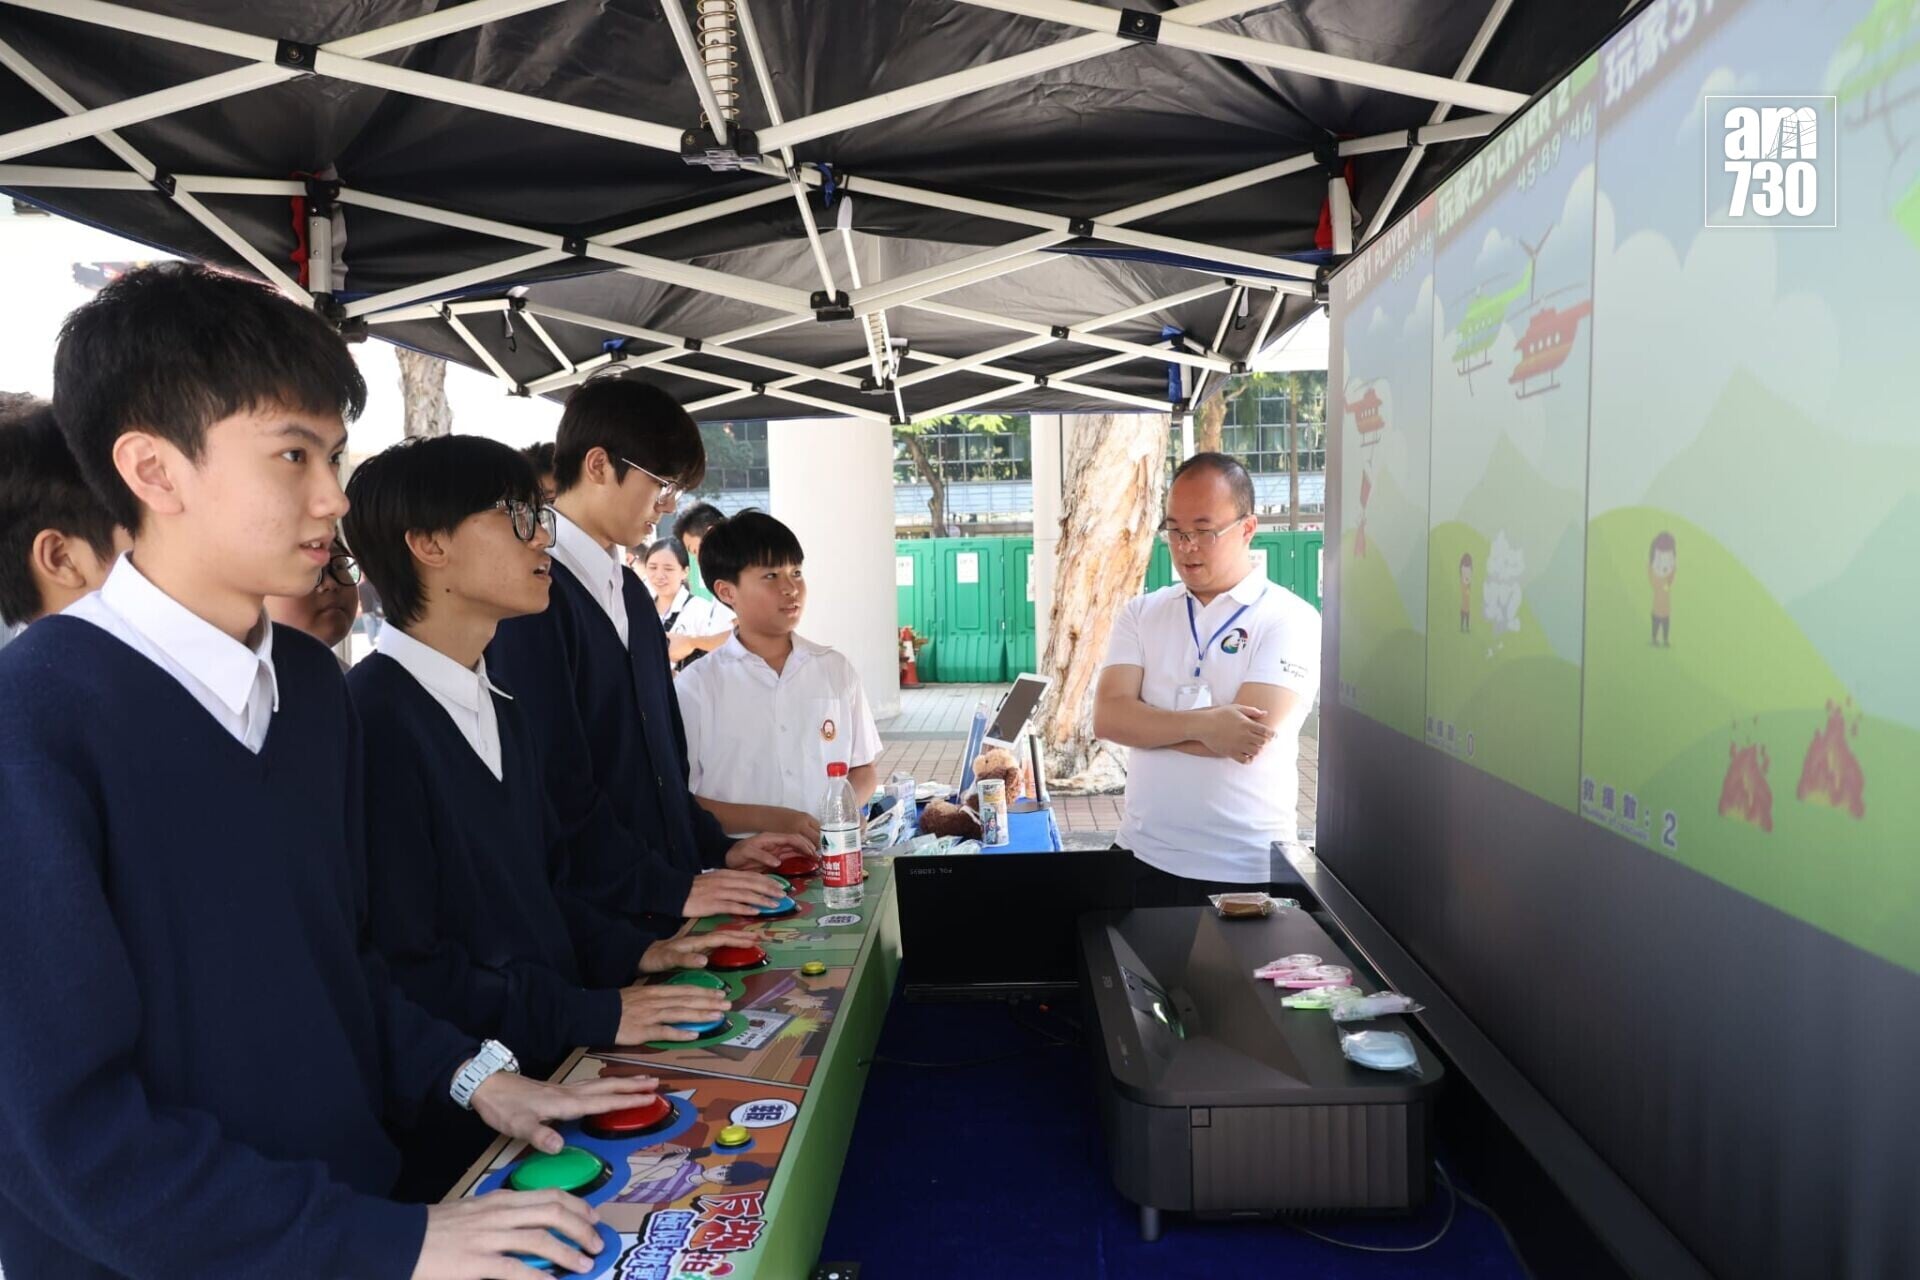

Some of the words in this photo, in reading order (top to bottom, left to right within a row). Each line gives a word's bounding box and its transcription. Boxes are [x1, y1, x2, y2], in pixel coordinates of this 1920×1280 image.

[1486, 93, 1552, 188] PLAYER
[1555, 76, 1571, 120] 2
[1663, 812, 1677, 849] 2
